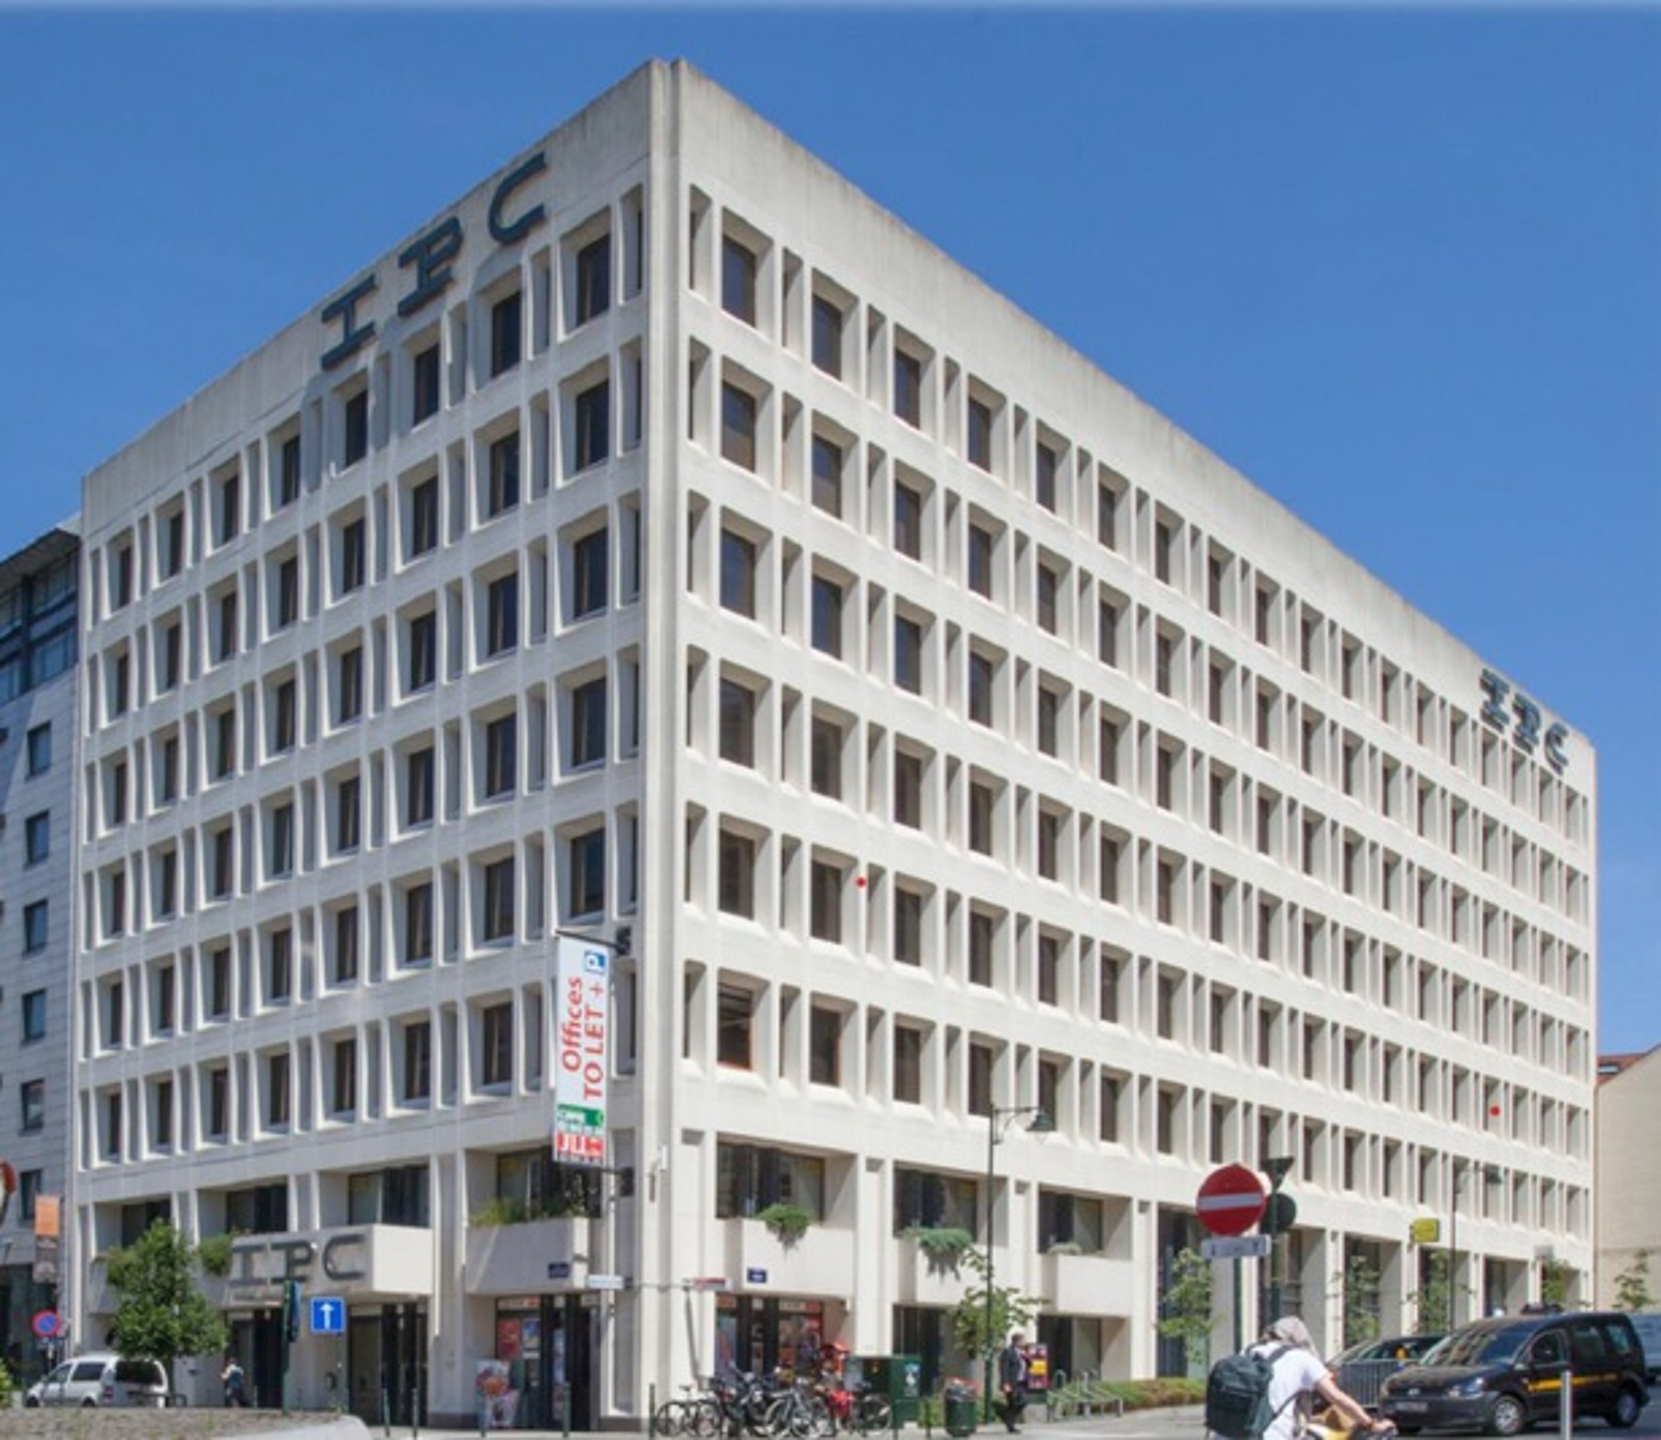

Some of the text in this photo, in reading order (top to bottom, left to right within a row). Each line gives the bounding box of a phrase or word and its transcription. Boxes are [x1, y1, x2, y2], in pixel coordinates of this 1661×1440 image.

[321, 152, 545, 370] IPC
[1481, 668, 1569, 769] IPC
[562, 976, 582, 1072] Offices
[584, 1004, 604, 1055] LET
[230, 1235, 366, 1286] IPC
